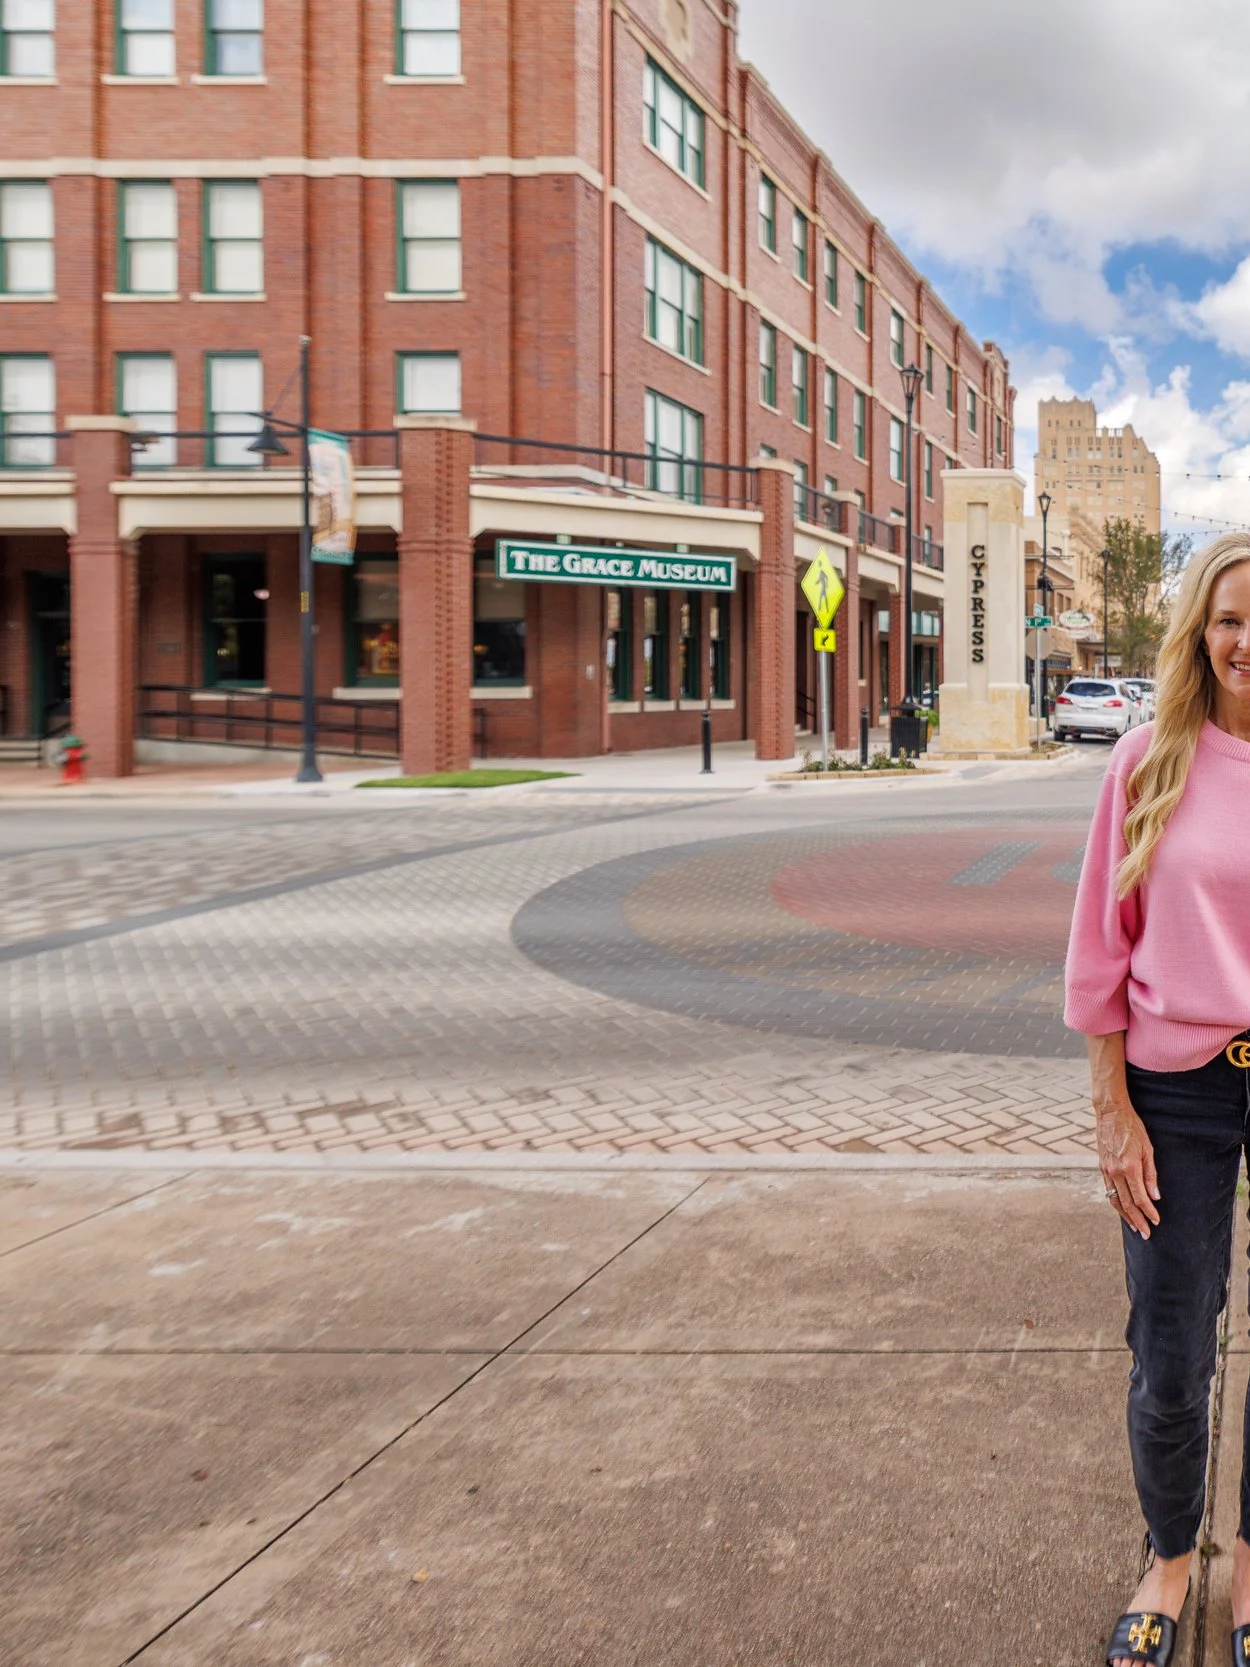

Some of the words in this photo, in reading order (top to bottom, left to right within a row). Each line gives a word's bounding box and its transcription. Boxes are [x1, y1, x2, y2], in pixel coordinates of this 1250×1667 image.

[509, 550, 561, 573] THE
[562, 553, 635, 577] GRACE
[637, 558, 728, 583] MUSEUM
[971, 544, 986, 664] CYPRESS
